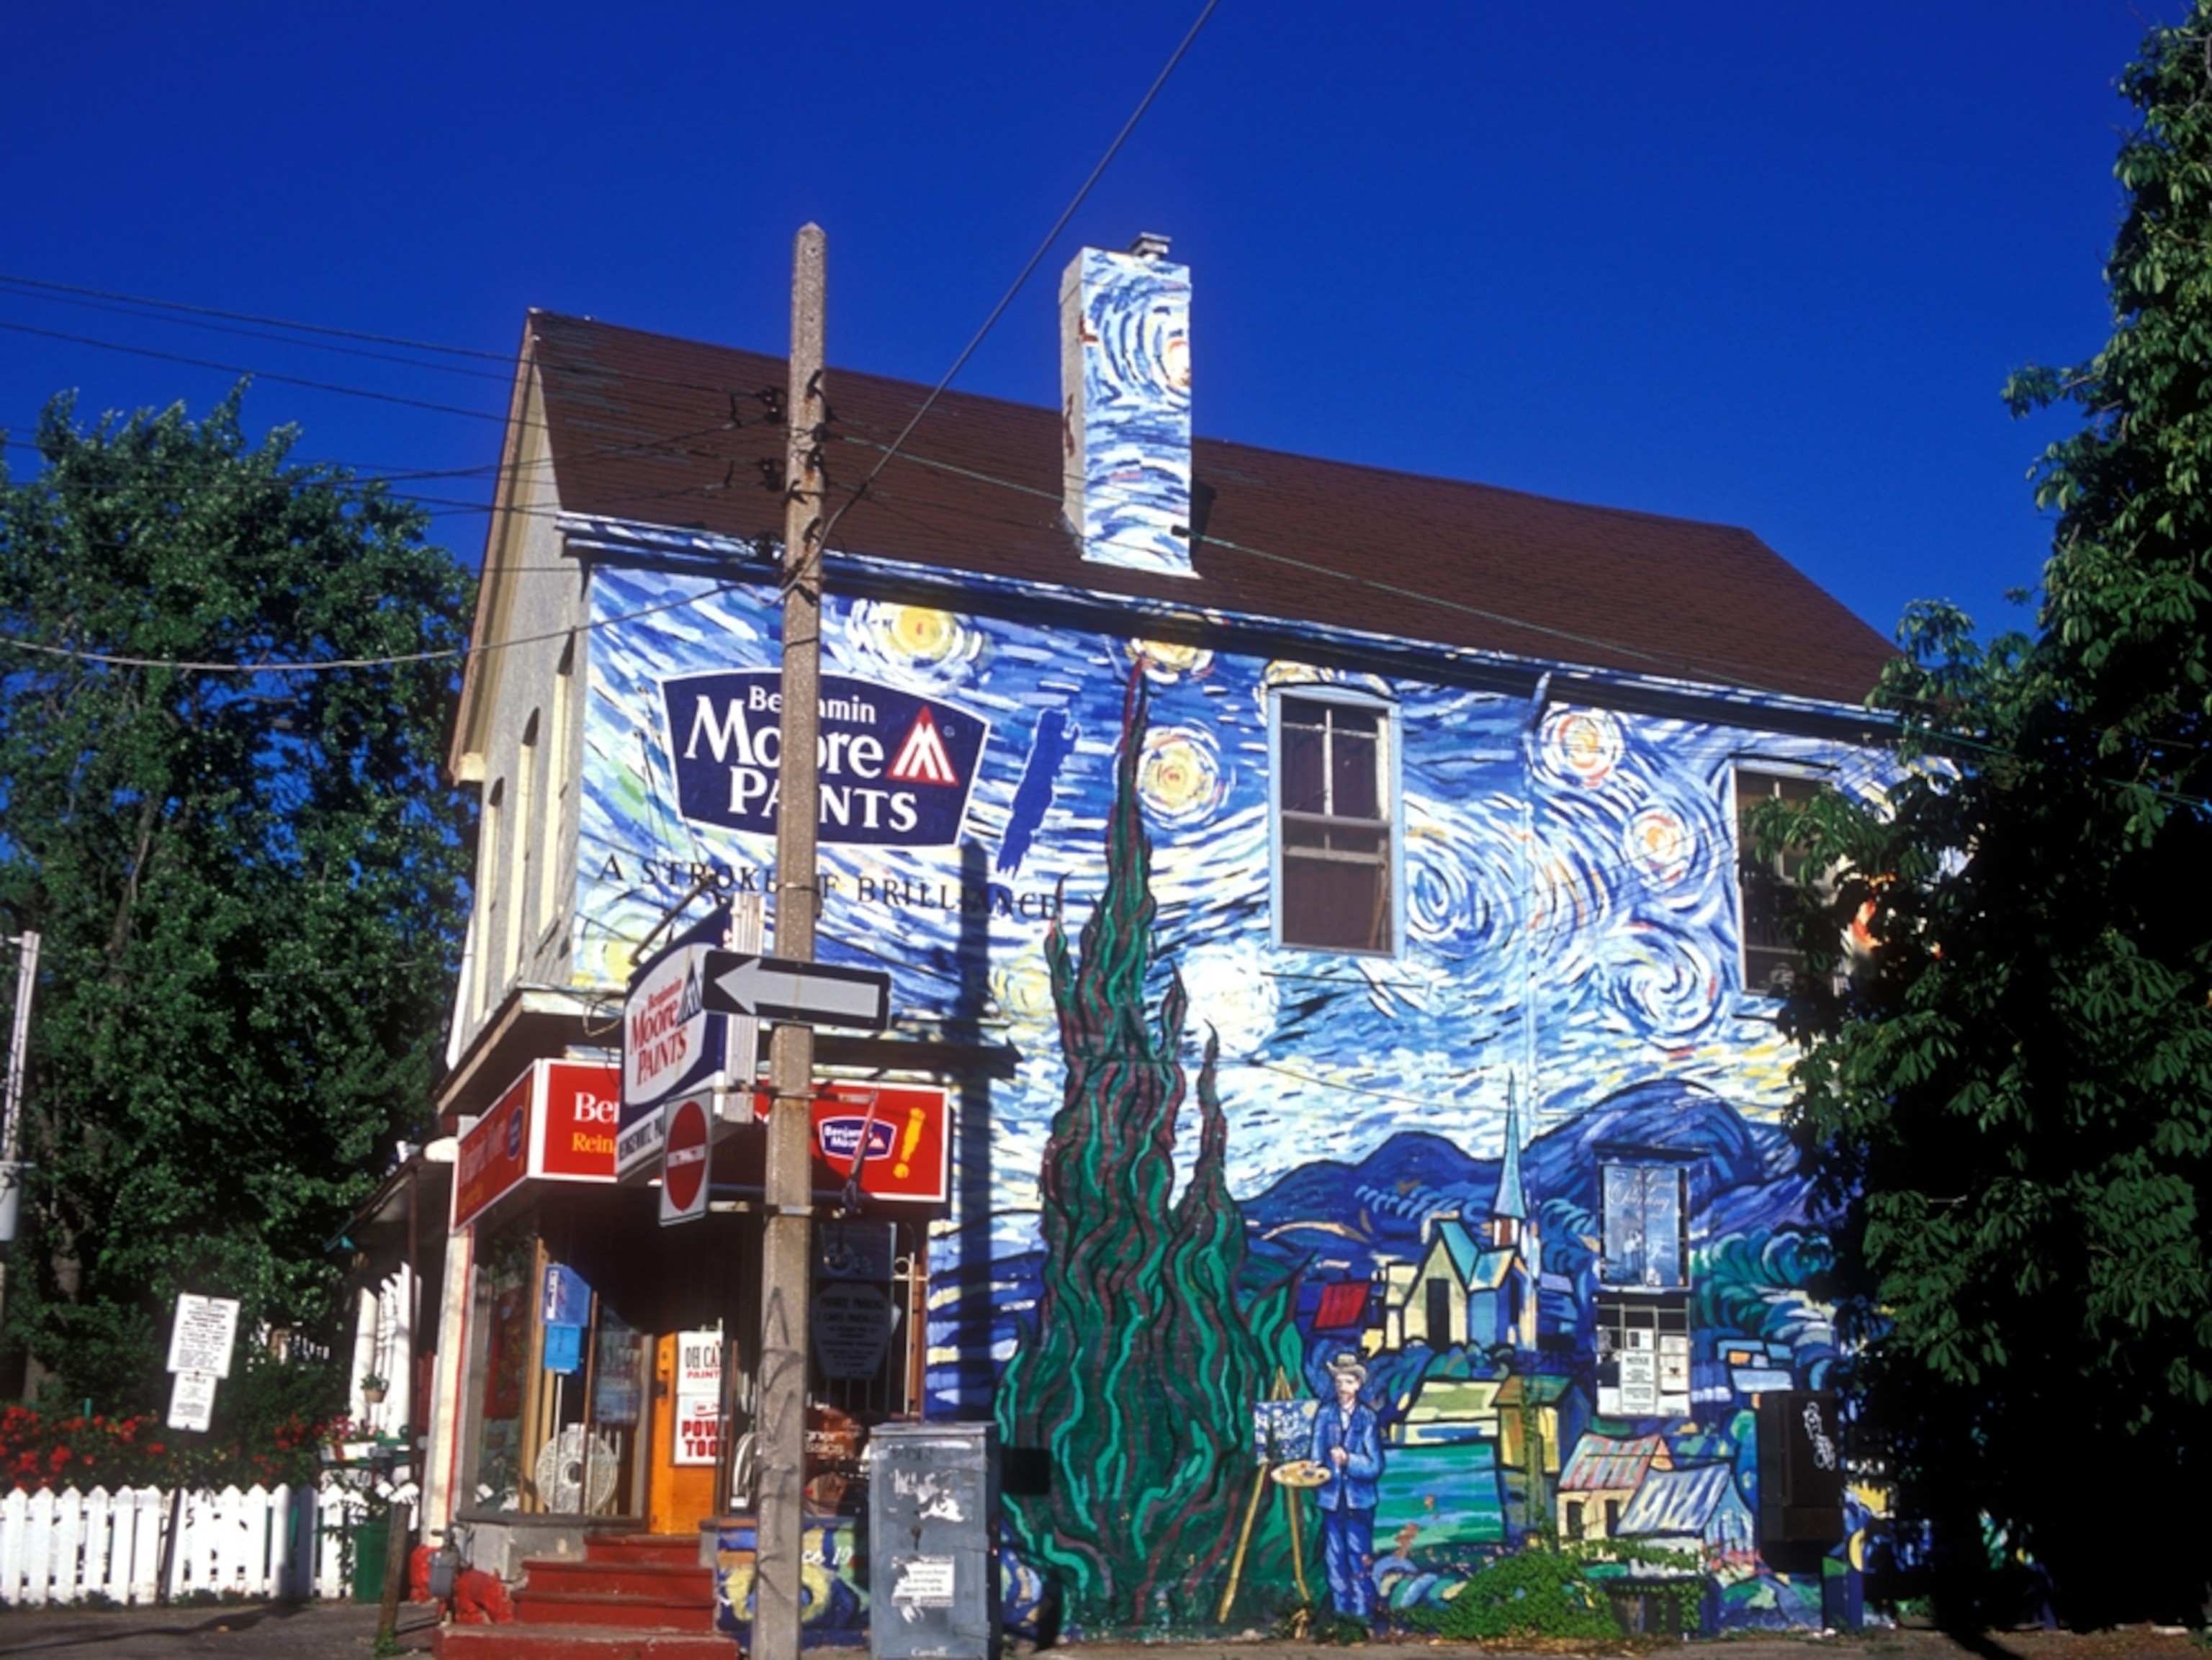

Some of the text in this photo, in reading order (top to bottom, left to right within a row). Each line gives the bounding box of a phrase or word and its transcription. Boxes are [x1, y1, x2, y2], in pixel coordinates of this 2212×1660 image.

[683, 695, 884, 779] More
[598, 853, 625, 882] A
[629, 999, 679, 1055] Moore
[637, 1025, 688, 1087] PAINTS
